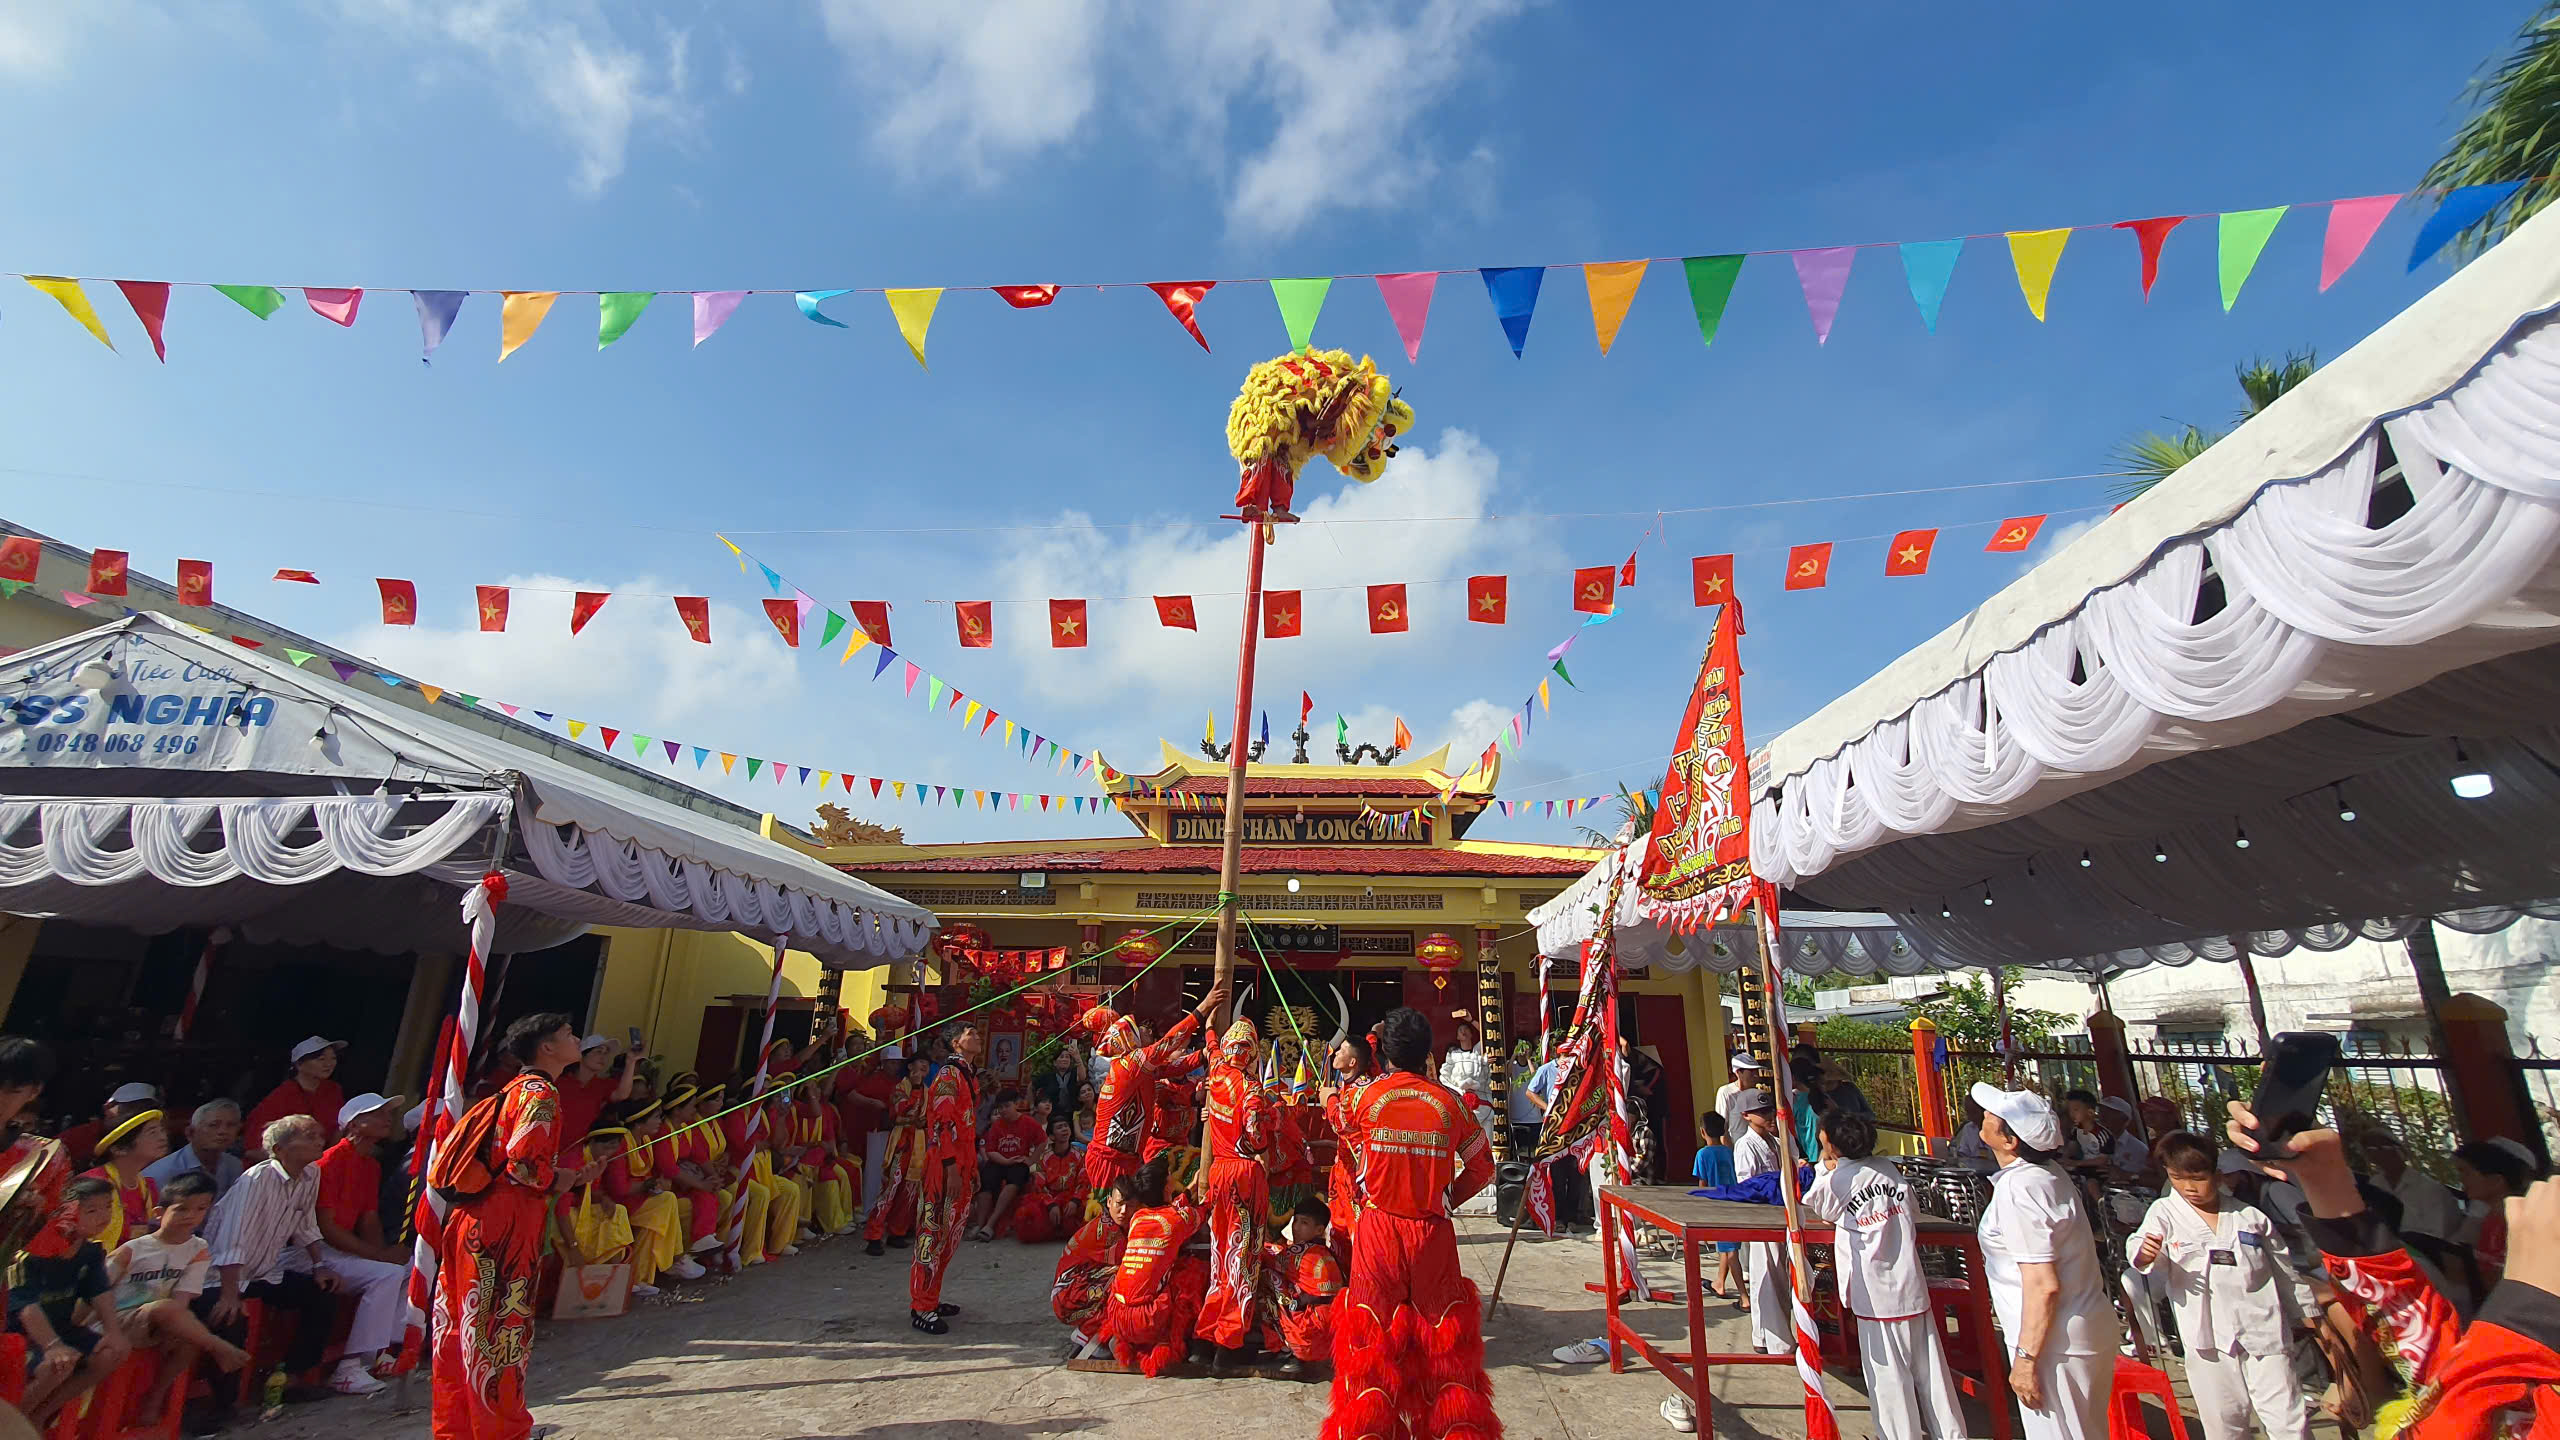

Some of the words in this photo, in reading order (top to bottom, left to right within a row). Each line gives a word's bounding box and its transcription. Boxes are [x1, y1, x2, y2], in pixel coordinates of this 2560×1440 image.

[107, 690, 273, 727] NGHĨA
[37, 733, 99, 752] 0848
[104, 733, 145, 753] 068
[153, 735, 199, 754] 496
[1305, 819, 1366, 841] LONG
[1846, 1184, 1905, 1216] TAEKWONDO
